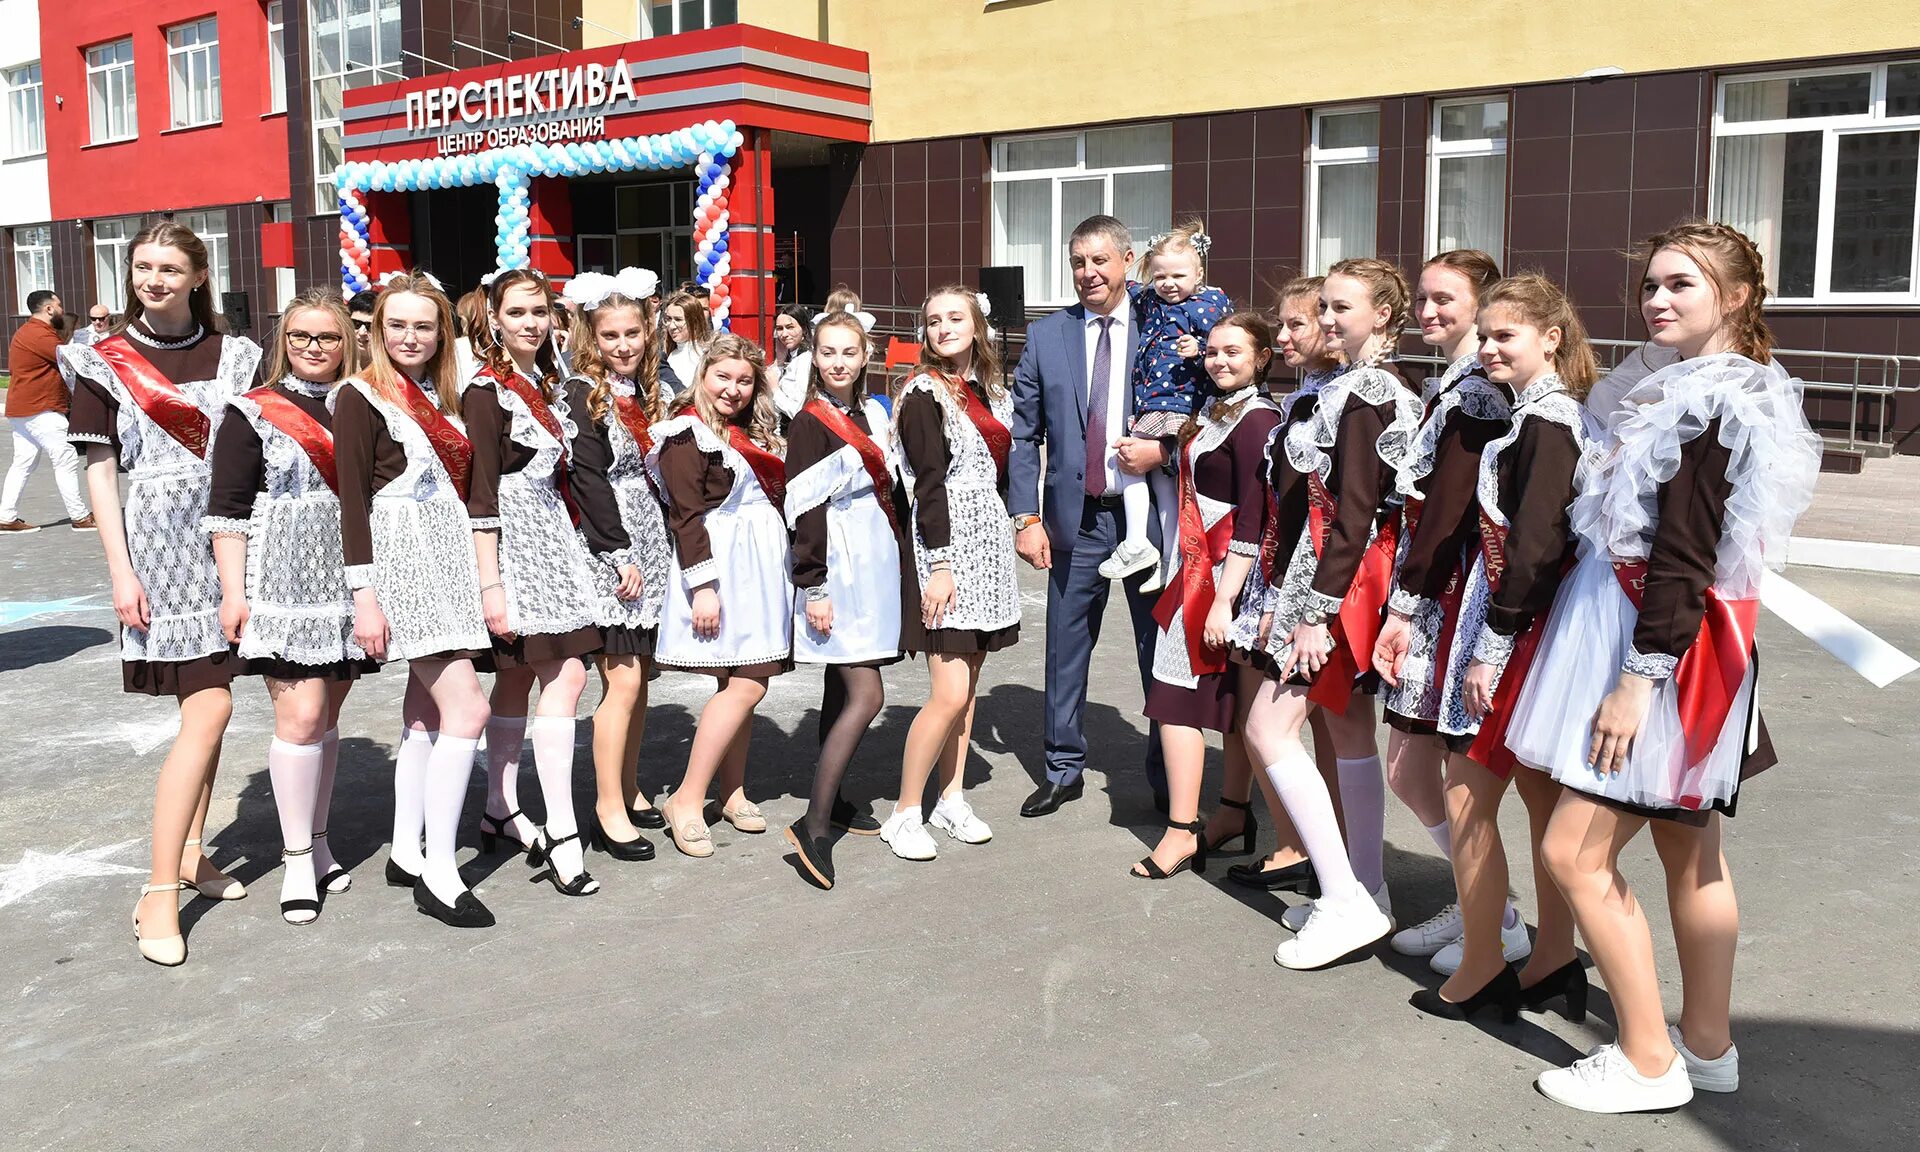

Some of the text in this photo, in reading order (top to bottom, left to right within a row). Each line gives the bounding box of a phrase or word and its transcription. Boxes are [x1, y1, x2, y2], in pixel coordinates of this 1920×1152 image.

[405, 58, 638, 131] ПЕРСПЕКТИВА
[437, 116, 605, 156] ЦЕНТР ОБРАЗОВАНИЯ
